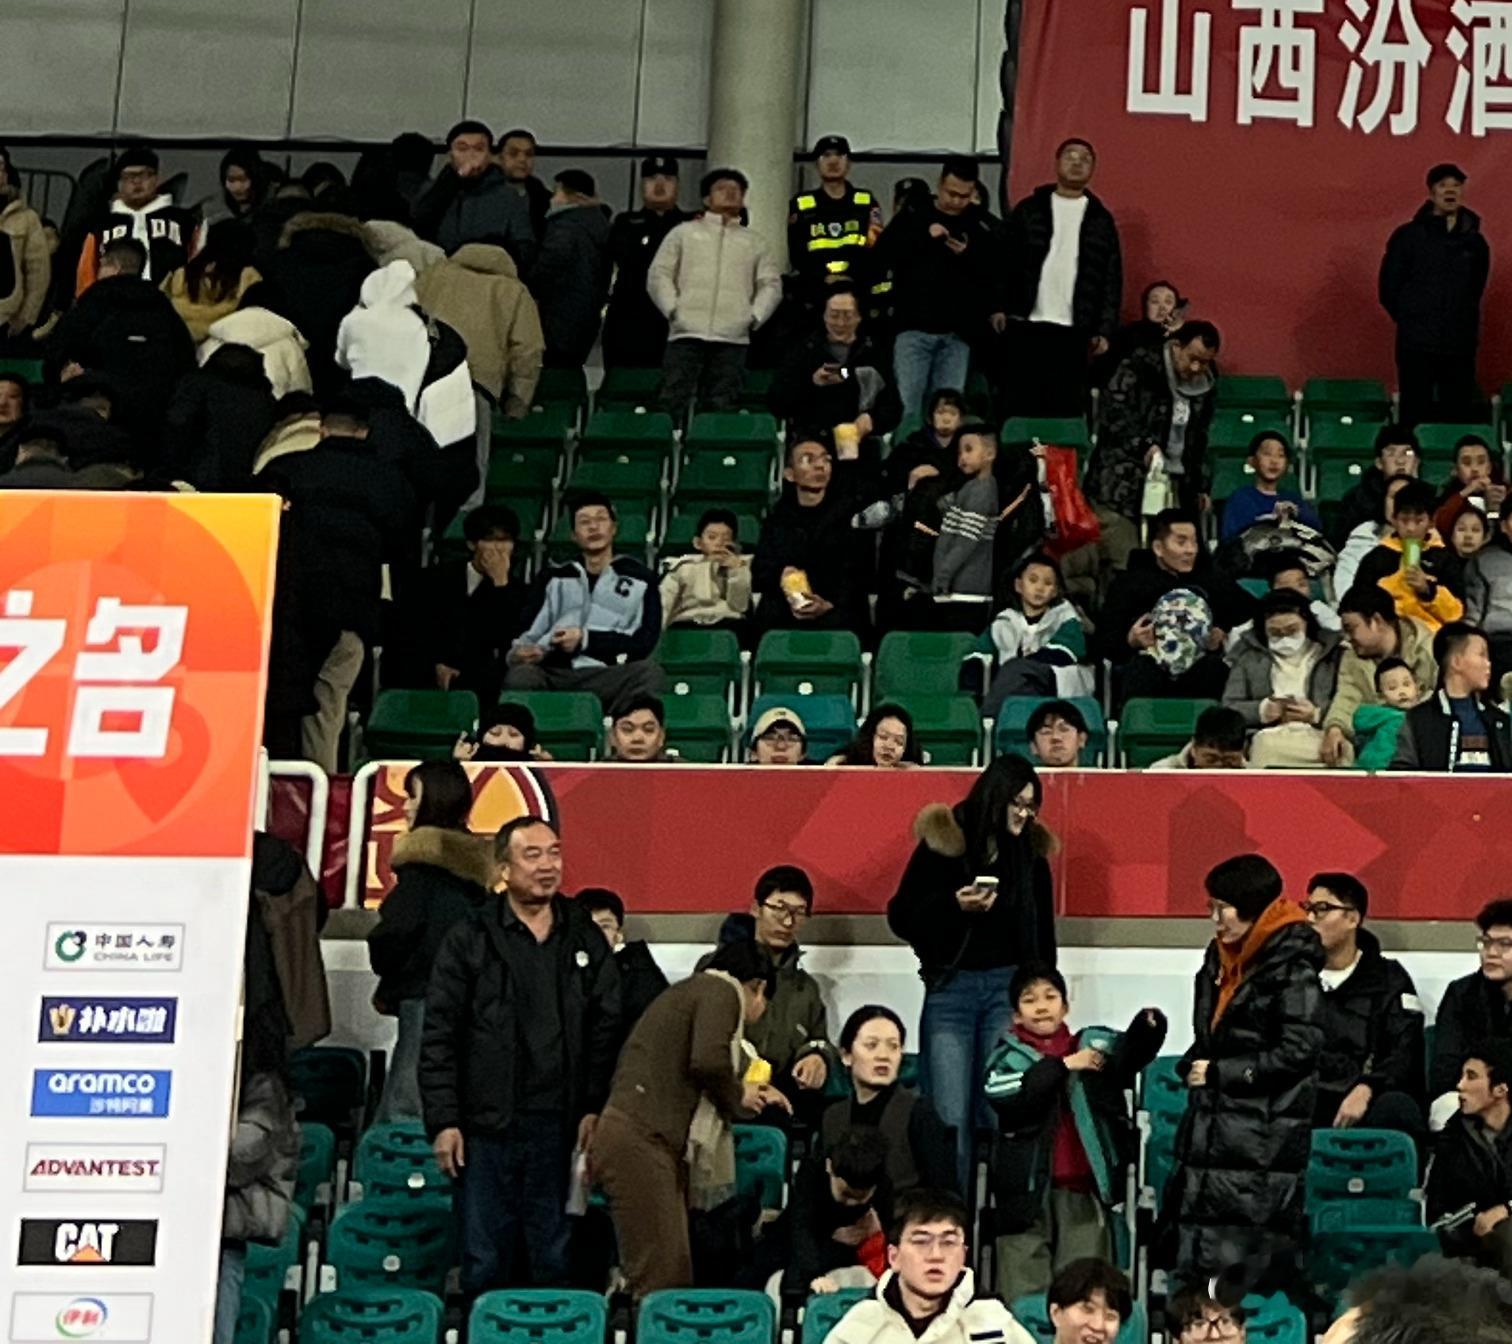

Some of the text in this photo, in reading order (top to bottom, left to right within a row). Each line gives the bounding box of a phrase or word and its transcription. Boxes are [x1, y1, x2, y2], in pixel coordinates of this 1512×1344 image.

[94, 932, 176, 949] 中国人寿
[49, 1072, 156, 1094] aramco
[31, 1159, 160, 1177] ADVANTEST
[55, 1222, 119, 1262] CAT
